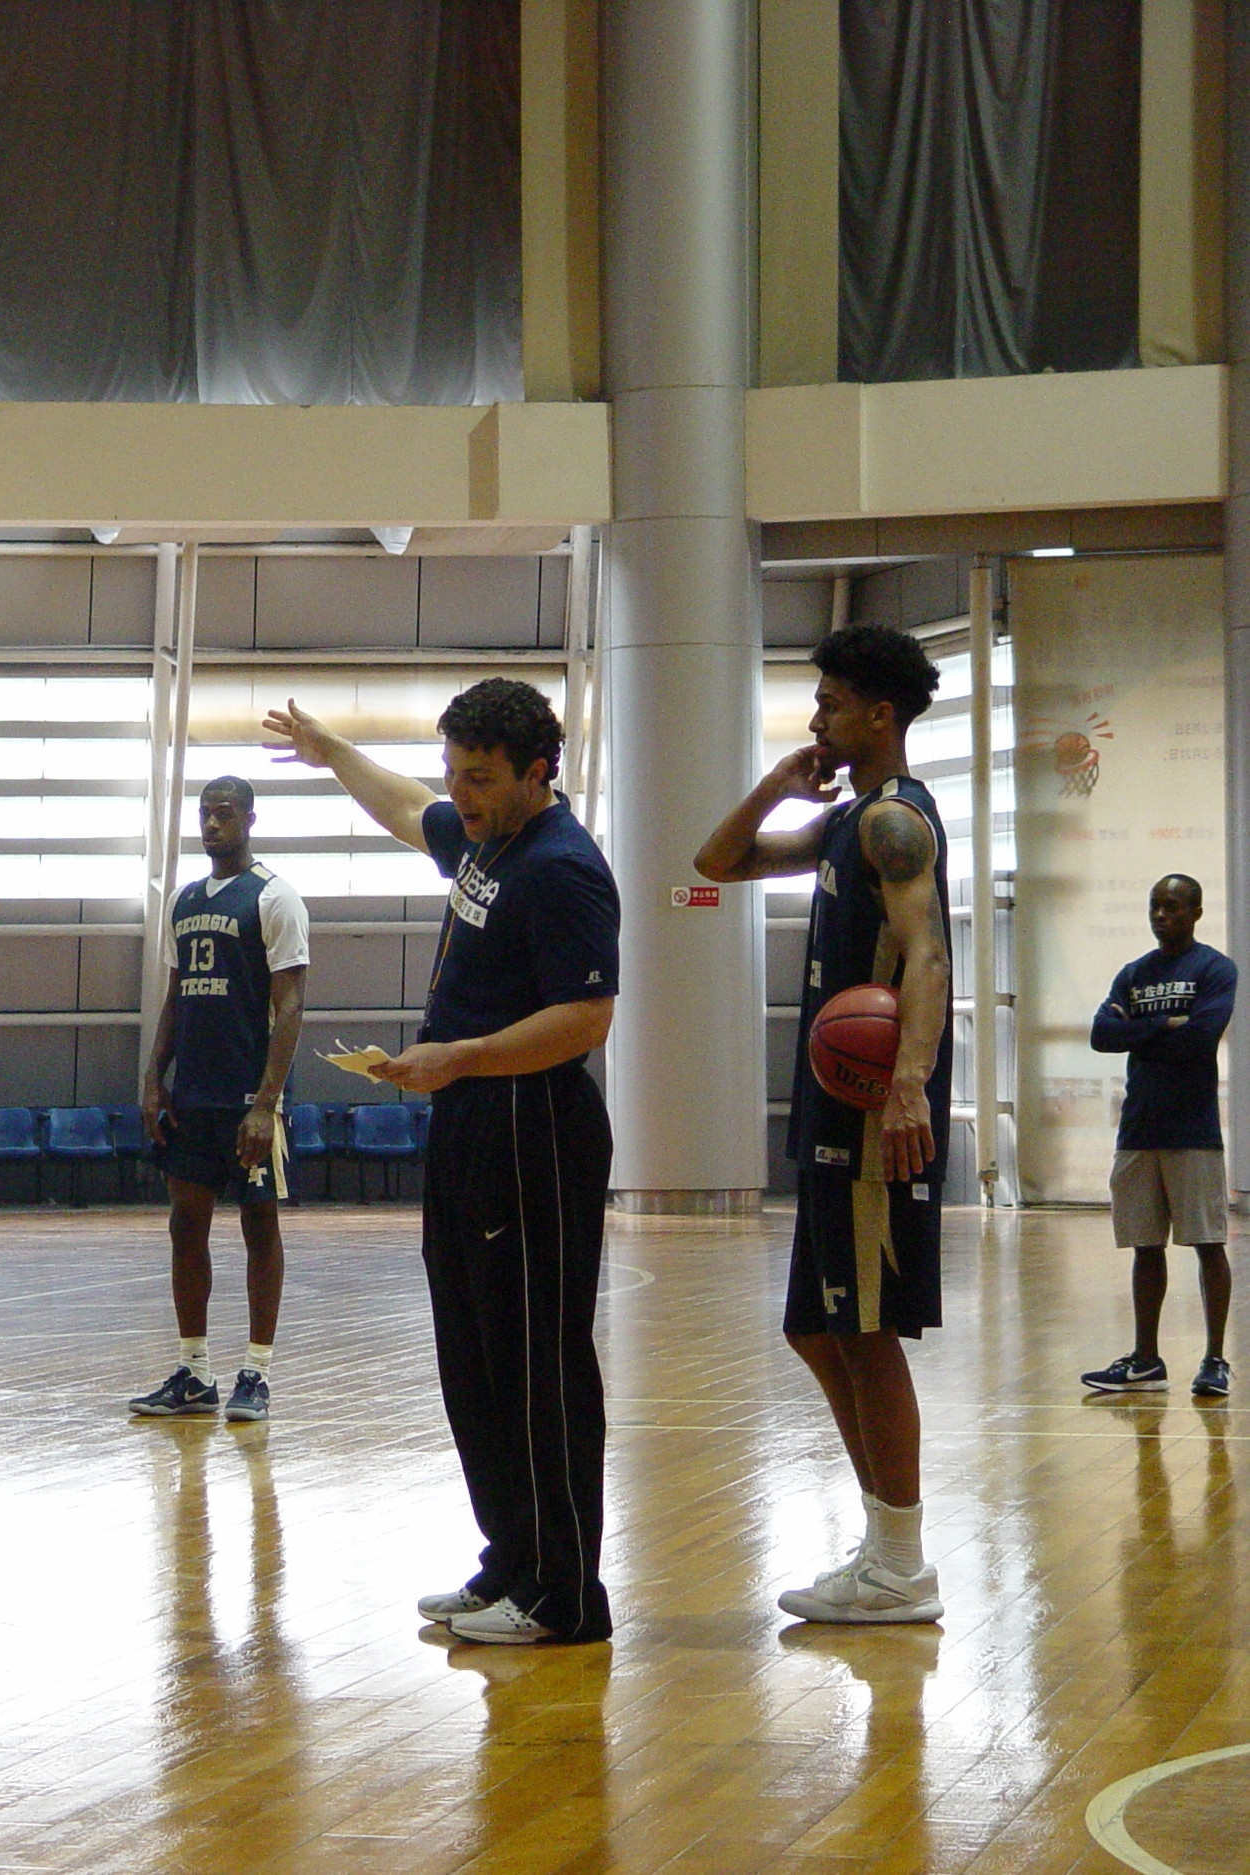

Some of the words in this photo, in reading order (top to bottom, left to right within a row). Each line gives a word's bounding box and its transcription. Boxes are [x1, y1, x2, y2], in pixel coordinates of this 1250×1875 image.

[175, 913, 241, 938] GEORGIA
[188, 938, 215, 973] 13
[180, 978, 229, 997] TECH
[835, 1062, 888, 1096] Wils
